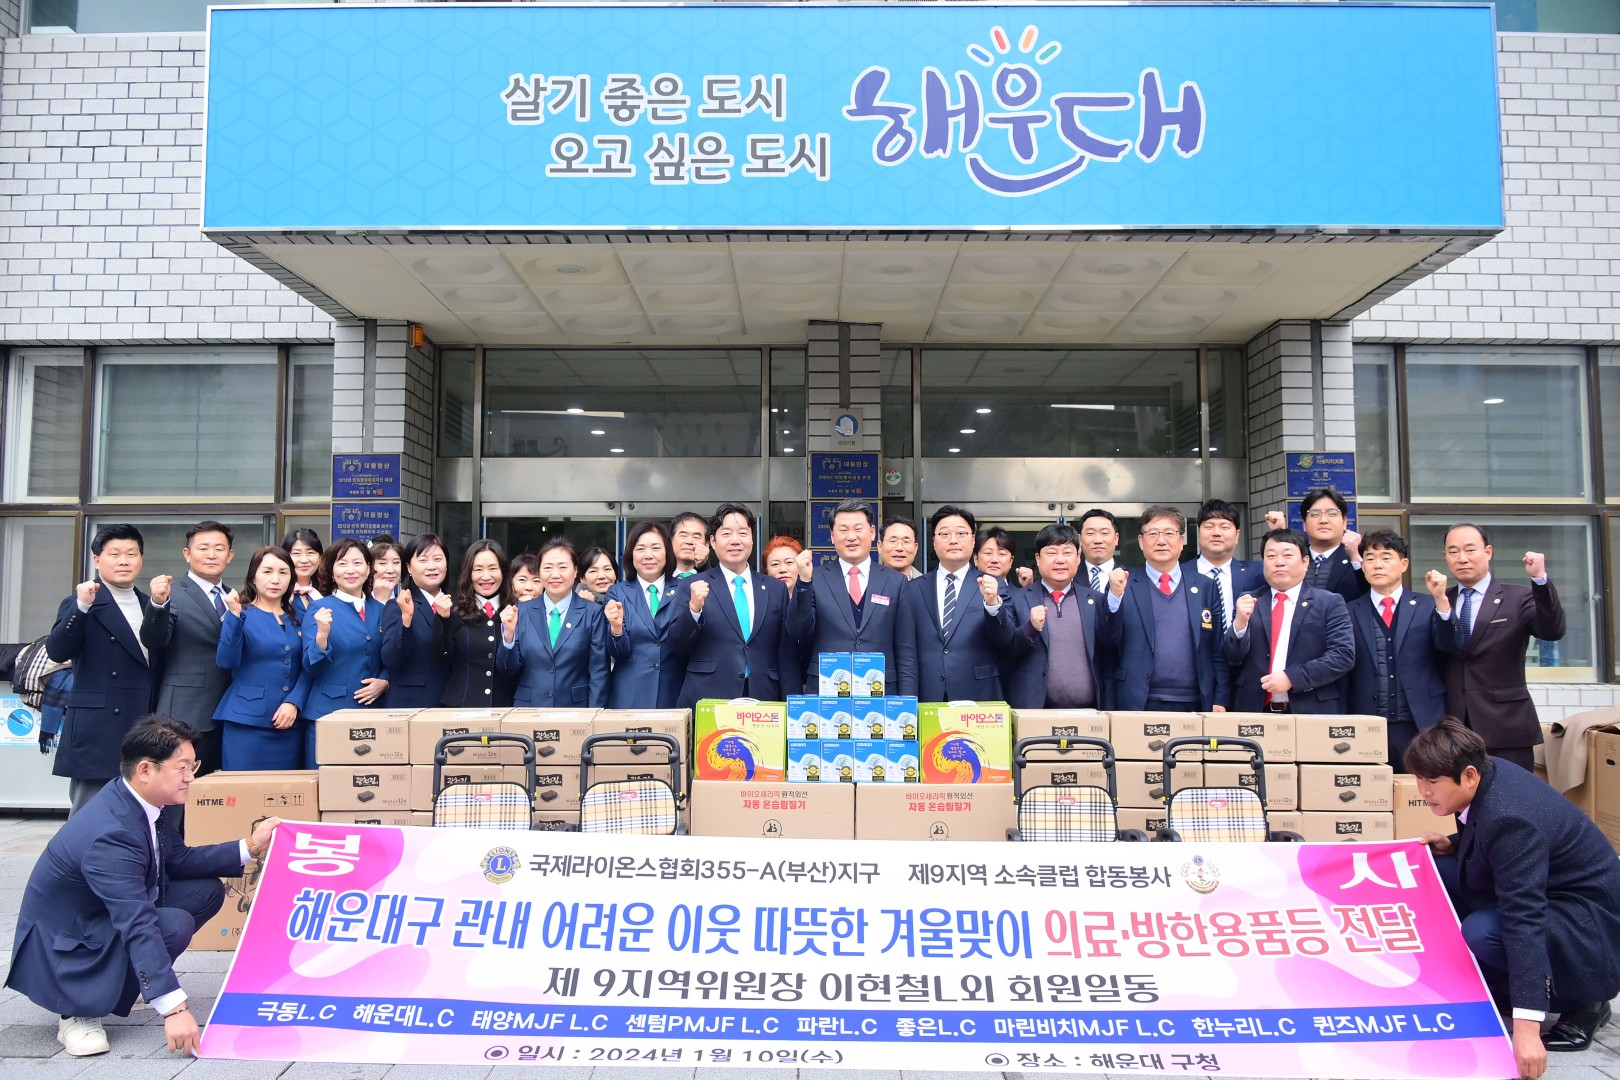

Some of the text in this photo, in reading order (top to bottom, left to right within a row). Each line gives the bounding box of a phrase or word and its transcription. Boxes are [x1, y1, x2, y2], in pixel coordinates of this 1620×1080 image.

[505, 76, 785, 120] 살기 좋은 도시
[847, 66, 1204, 163] 해운대
[549, 136, 829, 182] 오고 싶은 도시
[736, 711, 780, 726] 바이오스톤
[960, 713, 1004, 727] 바이오스톤
[740, 790, 808, 799] 바이오세라믹 원적외선
[742, 800, 806, 810] 자동 온습찜질기
[905, 791, 973, 800] 바이오세라믹 원적외선
[908, 802, 971, 812] 자동 온습찜질기
[287, 832, 361, 876] 봉
[529, 854, 881, 884] 국제라이온스협회355-A(부산)지구
[908, 863, 988, 886] 제9지역
[995, 864, 1079, 887] 소속클럽
[1085, 865, 1172, 888] 합동봉사
[1340, 851, 1420, 889] 사
[289, 889, 1422, 959] 해운대구 관내 어려운 이웃 따뜻한 겨울맞이 의료·방한용품등 전달
[543, 967, 1160, 1003] 제 9지역위원장 이현철L외 회원일동
[257, 1001, 337, 1022] 극동L.C
[353, 1003, 454, 1028] 해운대L.C
[471, 1009, 608, 1032] 태양MJF L.C
[625, 1013, 779, 1034] 센텀PMJF L.C
[796, 1016, 878, 1036] 파란L.C
[896, 1017, 977, 1037] 좋은L.C
[994, 1017, 1176, 1038] 마린비치MJF L.C
[1191, 1017, 1296, 1038] 한누리L.C
[1313, 1012, 1455, 1037] 퀸즈MJF L.C
[518, 1045, 565, 1062] 일시
[589, 1047, 683, 1062] 2024년
[695, 1048, 732, 1063] 1월
[742, 1049, 844, 1064] 10일(수)
[1017, 1052, 1068, 1068] 장소
[1089, 1052, 1165, 1070] 해운대
[1171, 1053, 1222, 1072] 구청
